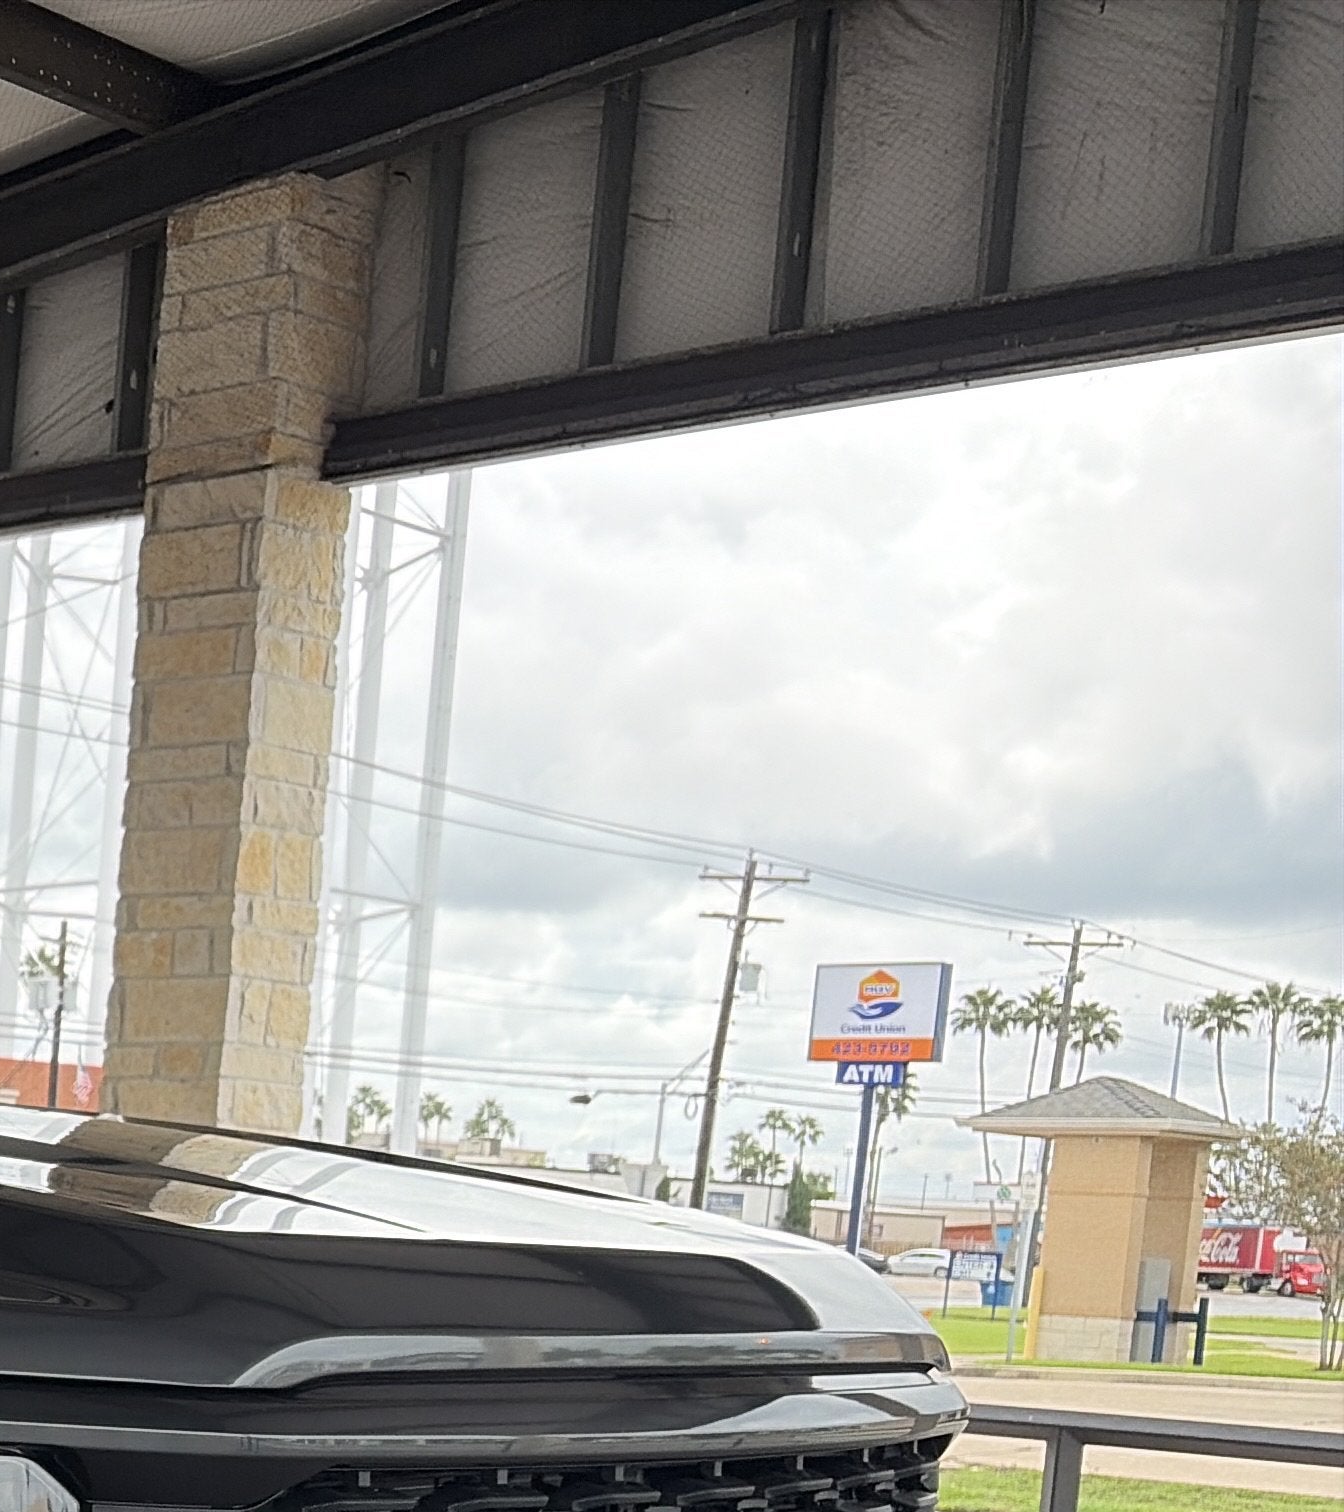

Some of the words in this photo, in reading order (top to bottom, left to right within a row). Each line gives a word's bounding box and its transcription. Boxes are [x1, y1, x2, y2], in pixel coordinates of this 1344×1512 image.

[840, 1023, 872, 1035] Credit
[874, 1023, 906, 1035] Union
[843, 1064, 894, 1084] ATM
